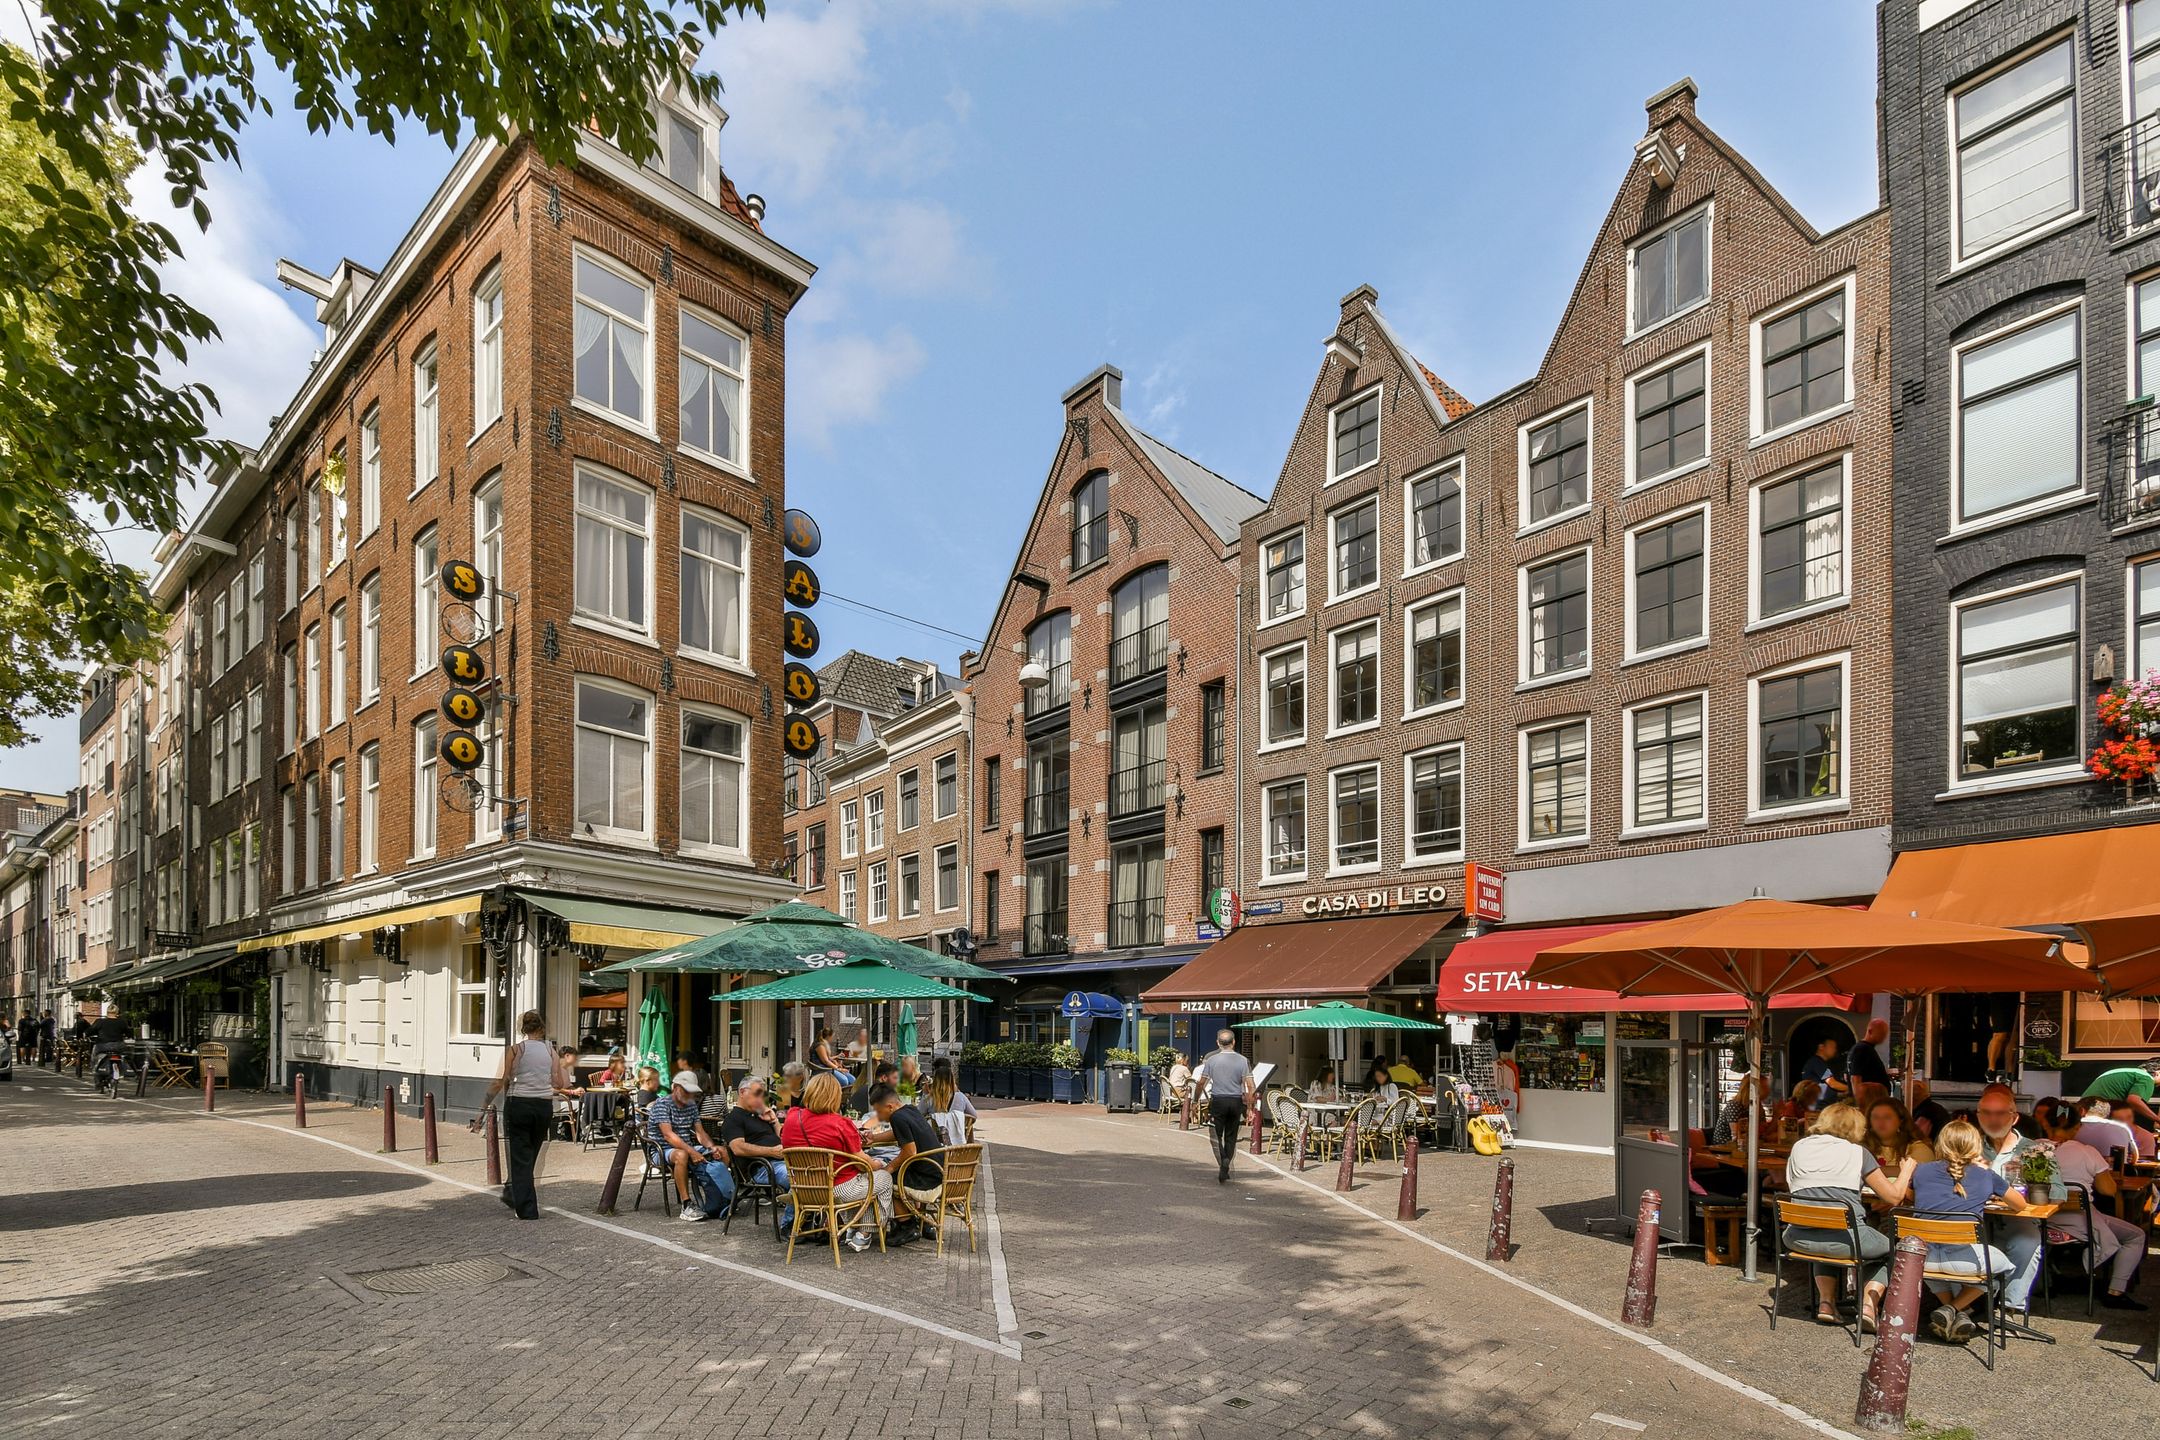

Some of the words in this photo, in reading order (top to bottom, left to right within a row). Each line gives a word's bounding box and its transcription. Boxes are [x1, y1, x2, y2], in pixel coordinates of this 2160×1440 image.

[1478, 872, 1502, 888] SOUVENIRS
[1482, 886, 1497, 899] TABAC
[1215, 898, 1237, 908] PIZZA
[1302, 894, 1361, 914] CASA
[1367, 891, 1388, 908] DI
[1397, 886, 1446, 905] LEO
[1480, 898, 1488, 910] SIM
[1488, 900, 1500, 912] CARD
[1214, 908, 1238, 917] PASTA
[159, 936, 191, 945] SHIRAZ
[1181, 1002, 1212, 1011] PIZZA
[1223, 1001, 1261, 1010] PASTA
[1273, 999, 1313, 1010] GRILL
